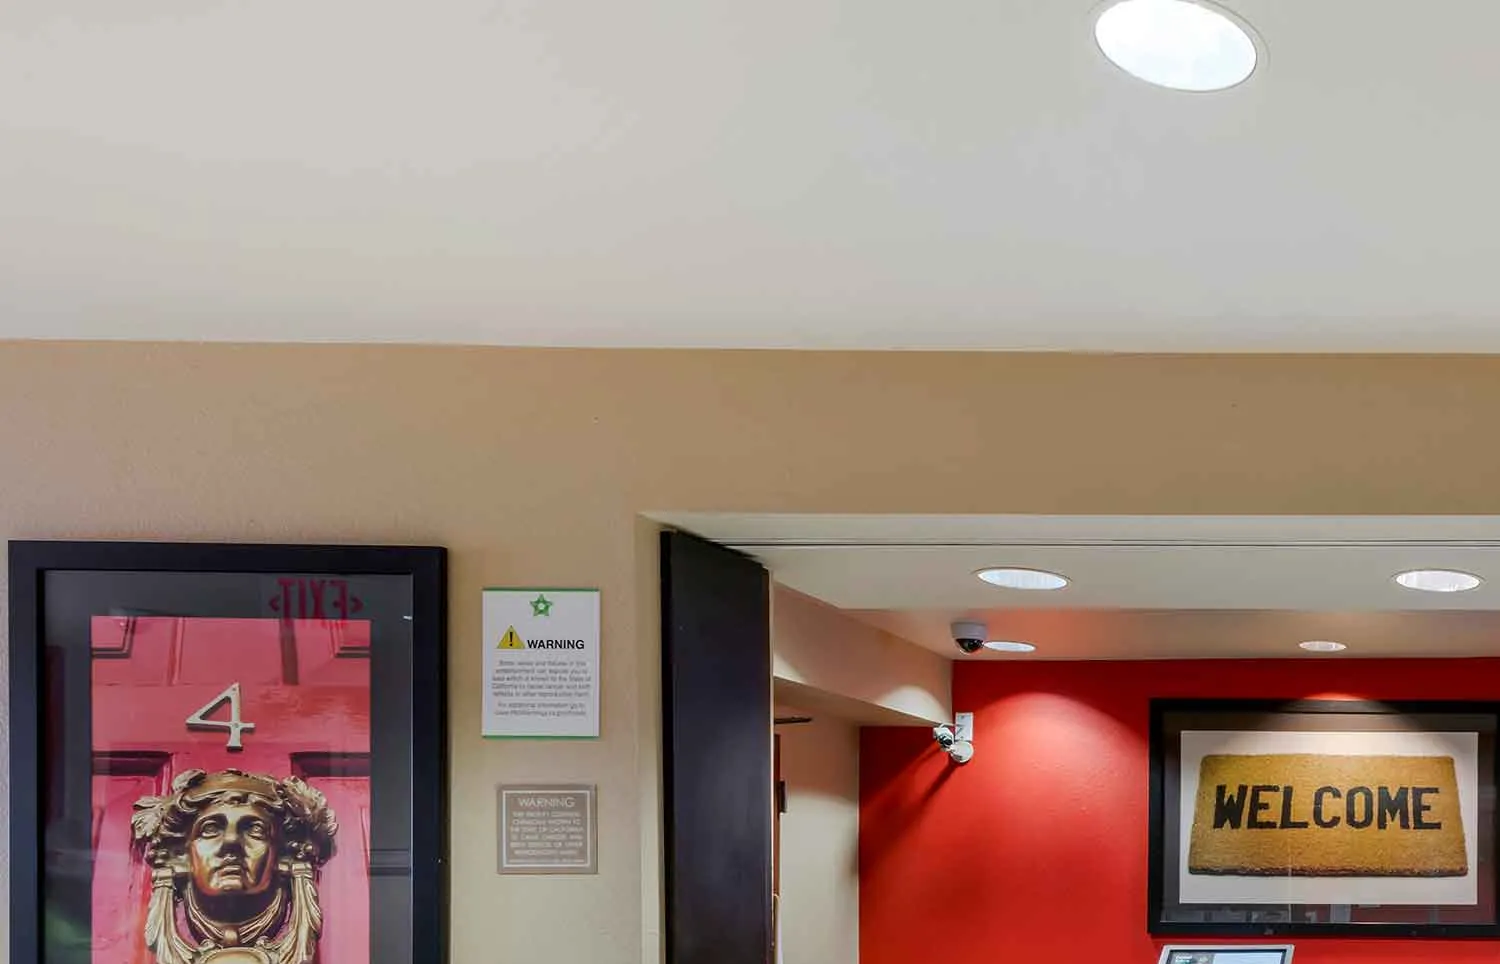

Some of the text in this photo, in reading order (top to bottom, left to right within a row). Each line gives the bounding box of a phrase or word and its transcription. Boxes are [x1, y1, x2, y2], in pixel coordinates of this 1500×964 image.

[527, 640, 584, 649] WARNING
[186, 682, 255, 750] 4
[518, 798, 575, 808] WARNING
[1213, 784, 1441, 830] WELCOME
